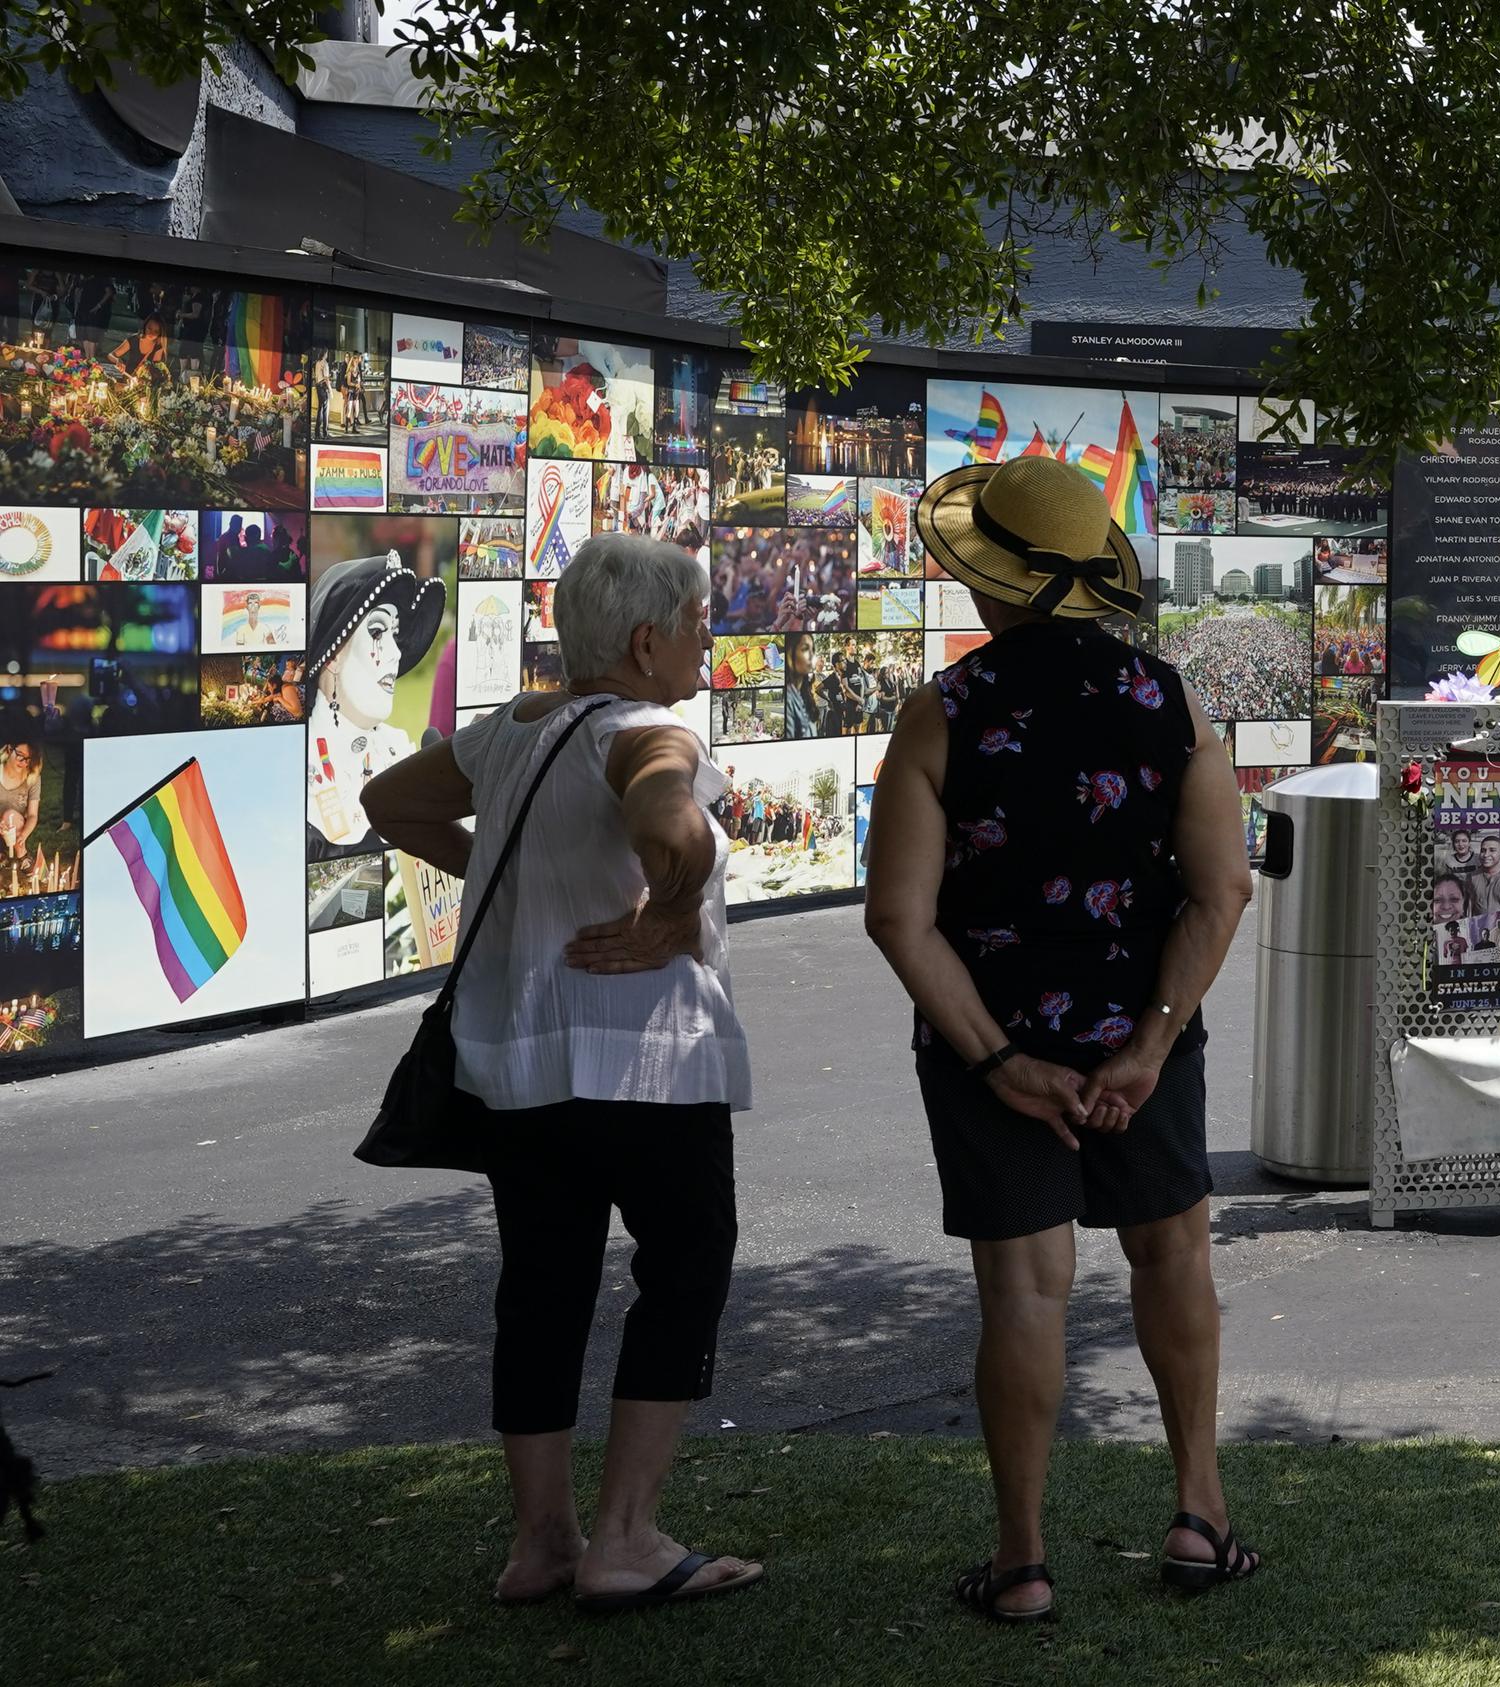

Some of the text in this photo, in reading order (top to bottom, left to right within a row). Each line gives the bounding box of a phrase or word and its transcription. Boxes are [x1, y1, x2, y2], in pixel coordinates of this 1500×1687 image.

[1072, 336, 1113, 344] STANLEY
[1115, 337, 1173, 346] ALMODOVAR
[480, 445, 513, 466] HATE
[1420, 456, 1476, 464] CHRISTOPHER
[1440, 767, 1488, 779] YOU
[1440, 812, 1461, 825] BE
[1450, 969, 1465, 977] IN
[1437, 981, 1498, 995] STANLEY
[1450, 1001, 1476, 1009] JUNE
